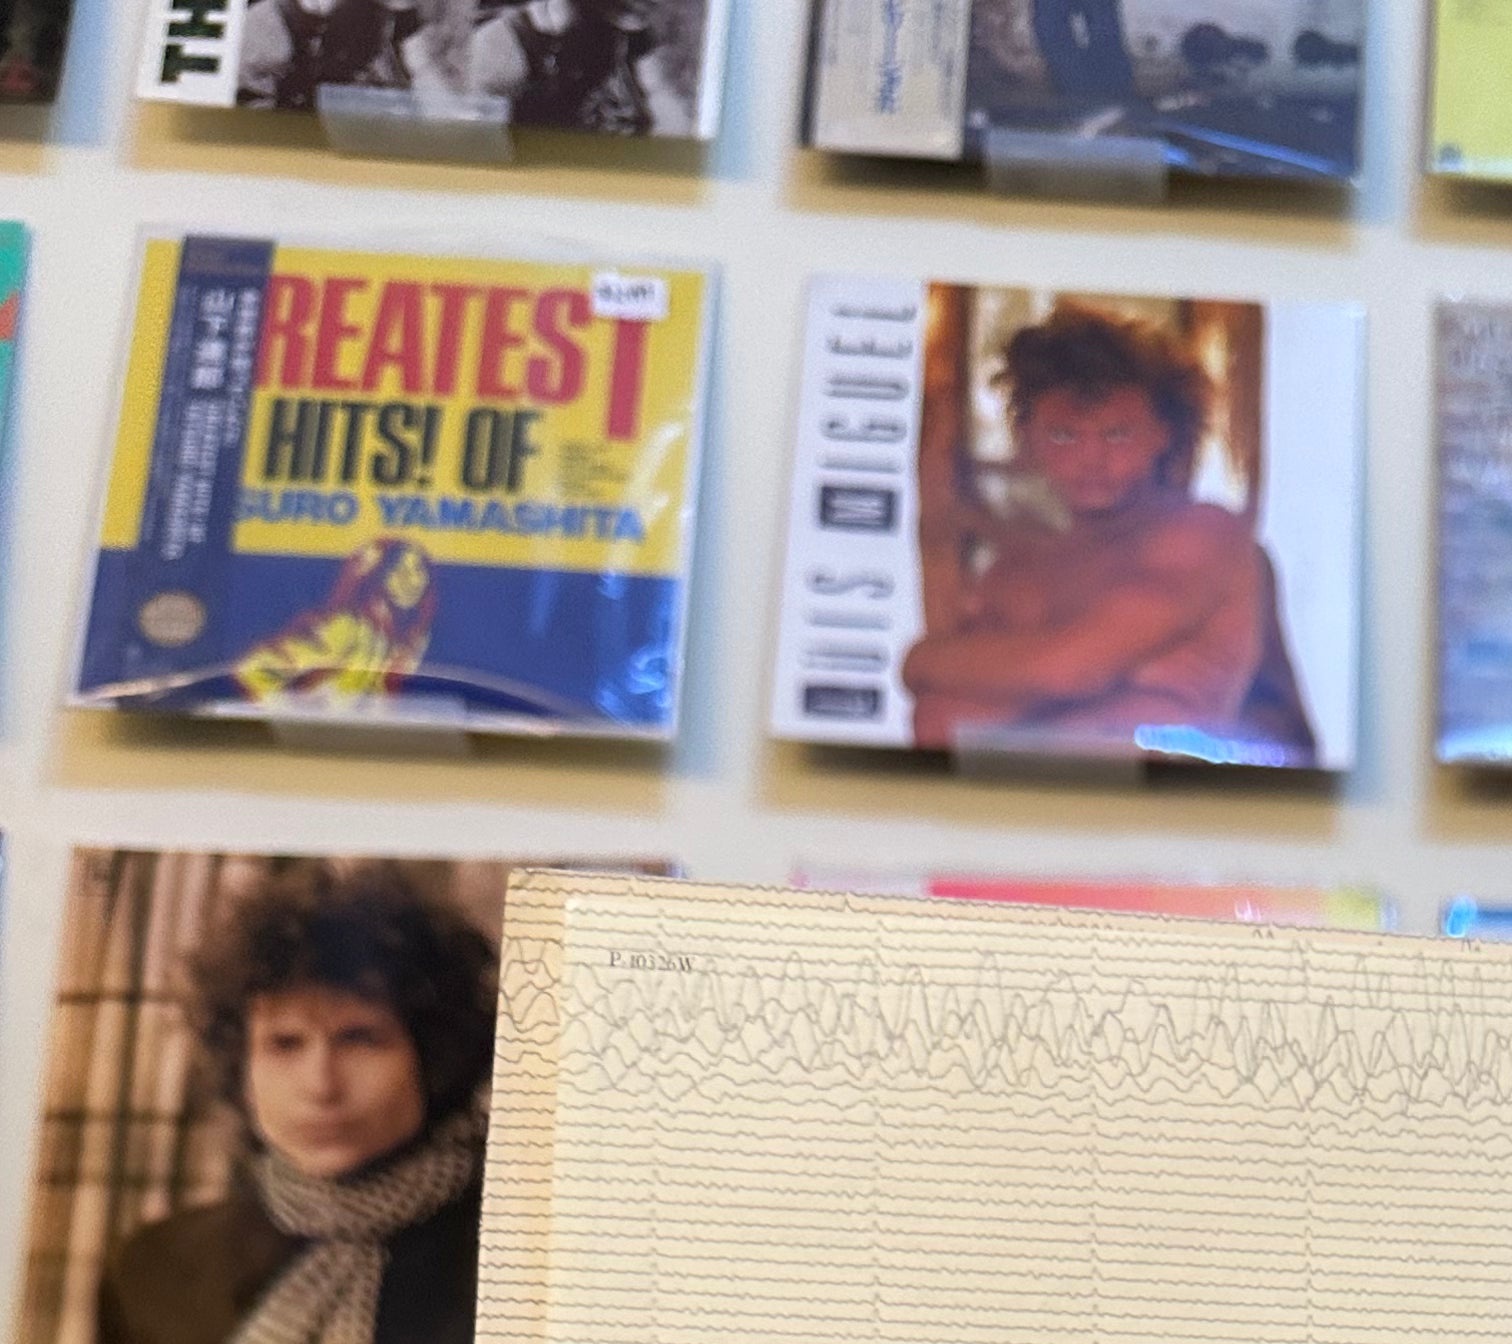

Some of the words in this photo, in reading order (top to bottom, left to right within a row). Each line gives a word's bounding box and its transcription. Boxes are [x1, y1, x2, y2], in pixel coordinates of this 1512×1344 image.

[261, 397, 442, 490] HITS!
[460, 405, 544, 493] OF
[816, 304, 918, 531] MIGUEL
[374, 494, 646, 542] YAMASHITA
